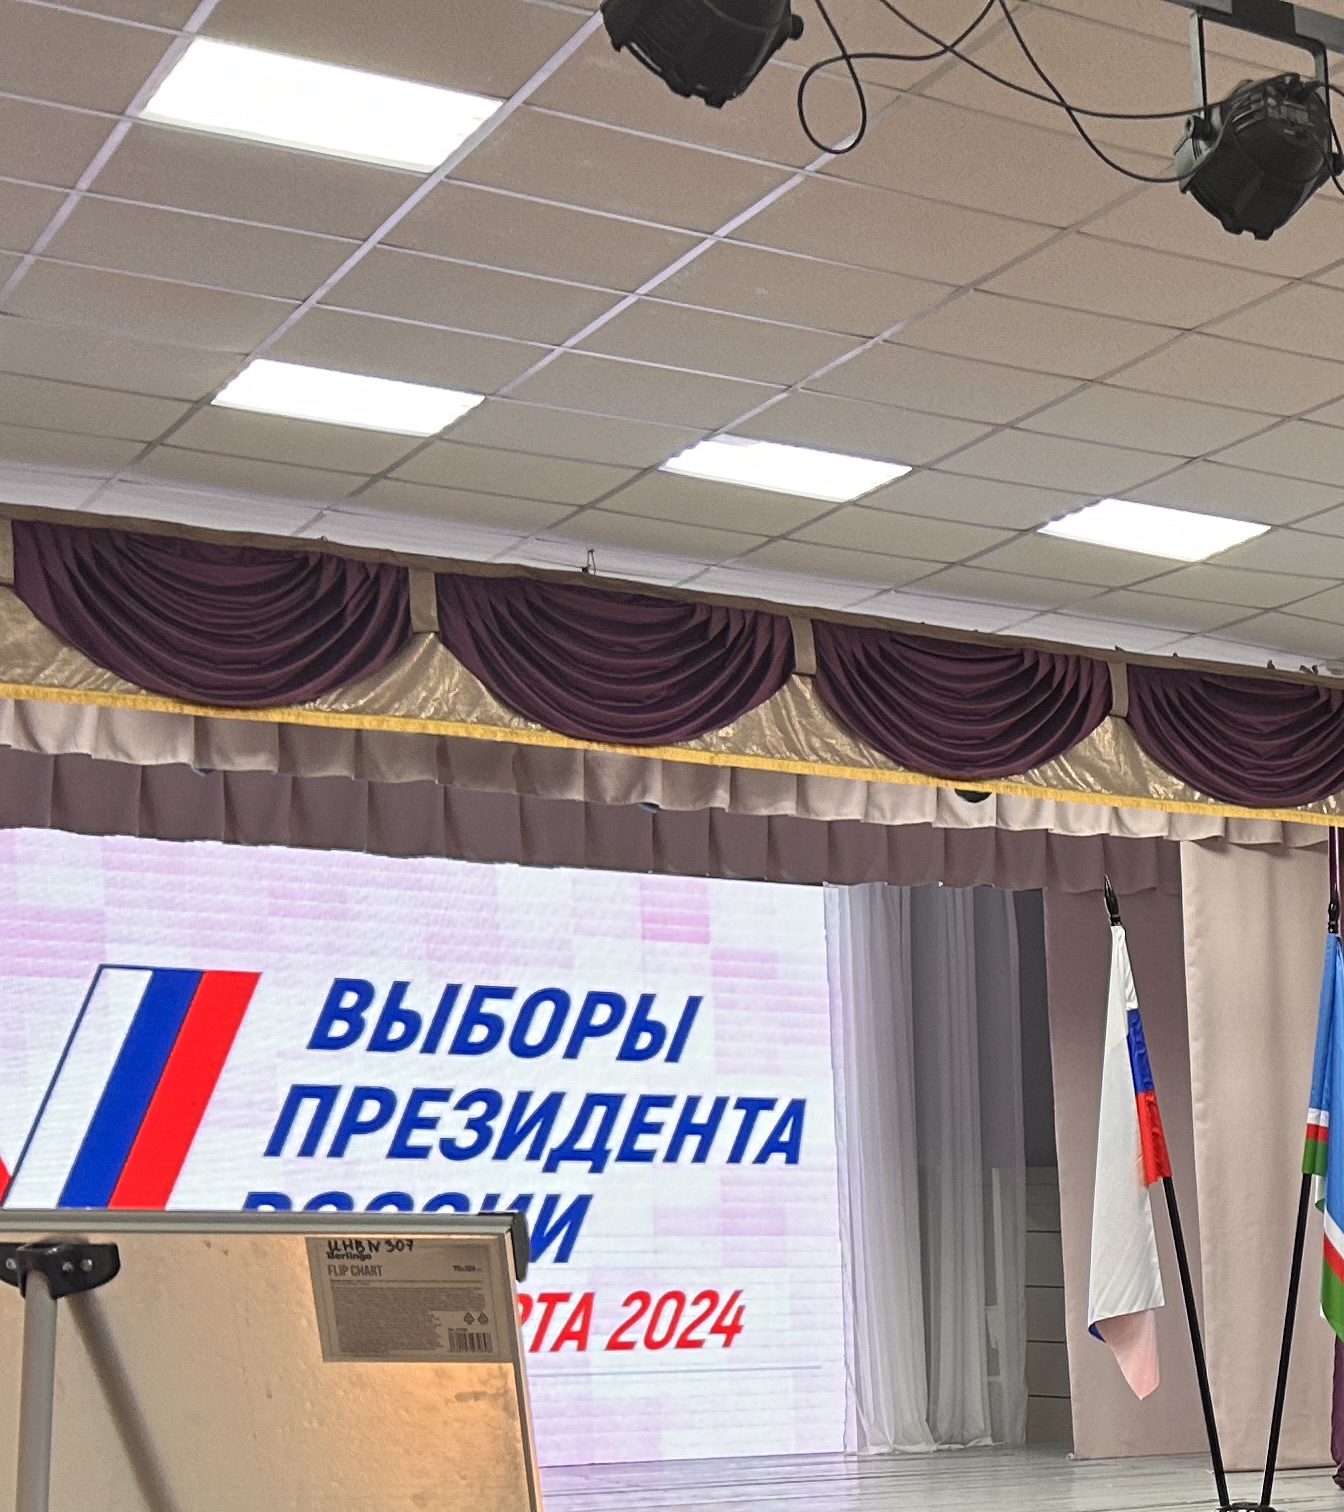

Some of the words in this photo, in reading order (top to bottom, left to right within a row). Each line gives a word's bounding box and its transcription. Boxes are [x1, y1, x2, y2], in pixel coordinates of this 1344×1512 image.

[307, 977, 703, 1062] ВЫБОРЫ
[263, 1084, 806, 1173] ПРЕЗИДЕНТА
[604, 1289, 746, 1350] 2024
